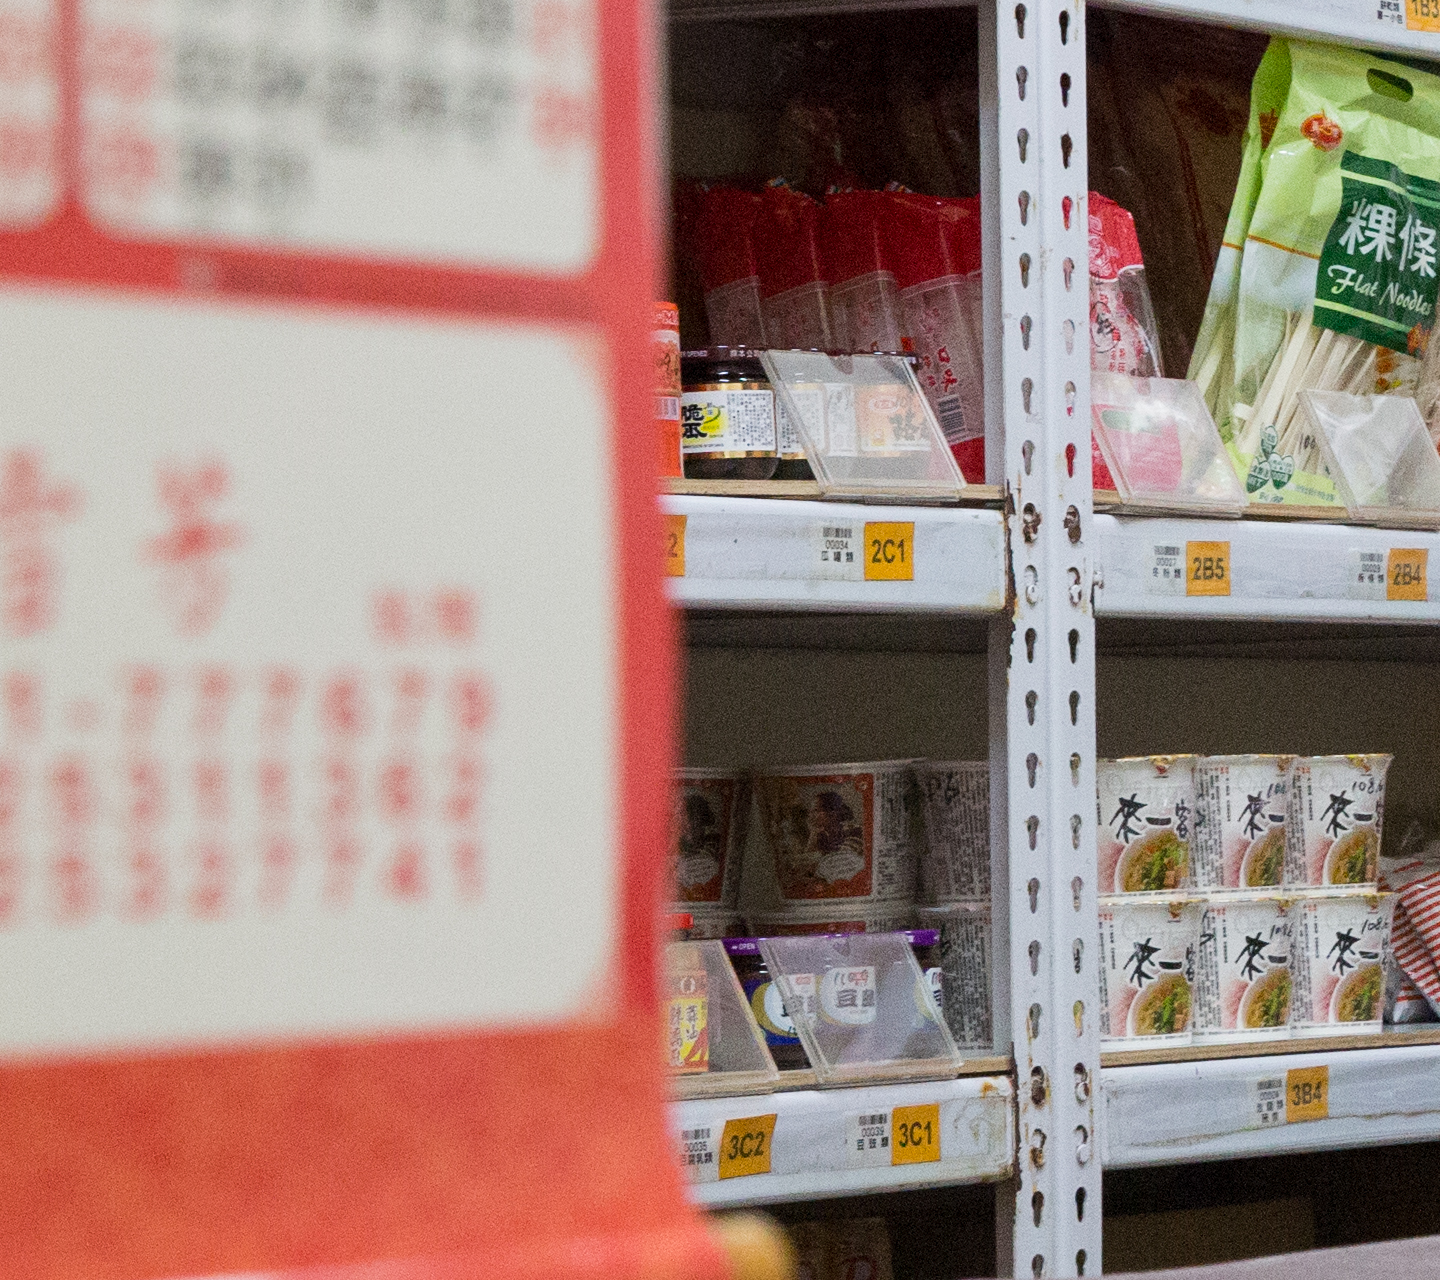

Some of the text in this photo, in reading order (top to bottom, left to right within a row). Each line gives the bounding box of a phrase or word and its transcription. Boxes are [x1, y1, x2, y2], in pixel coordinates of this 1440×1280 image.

[1339, 198, 1437, 278] 粿條
[1327, 265, 1432, 316] Flat Noodles
[872, 538, 905, 564] 2C1
[1192, 557, 1224, 580] 2B5
[1393, 564, 1422, 586] 2B4
[1109, 793, 1191, 844] 來一客
[1291, 1079, 1323, 1106] 3B4
[728, 1131, 765, 1160] 3C2
[899, 1121, 931, 1148] 3C1
